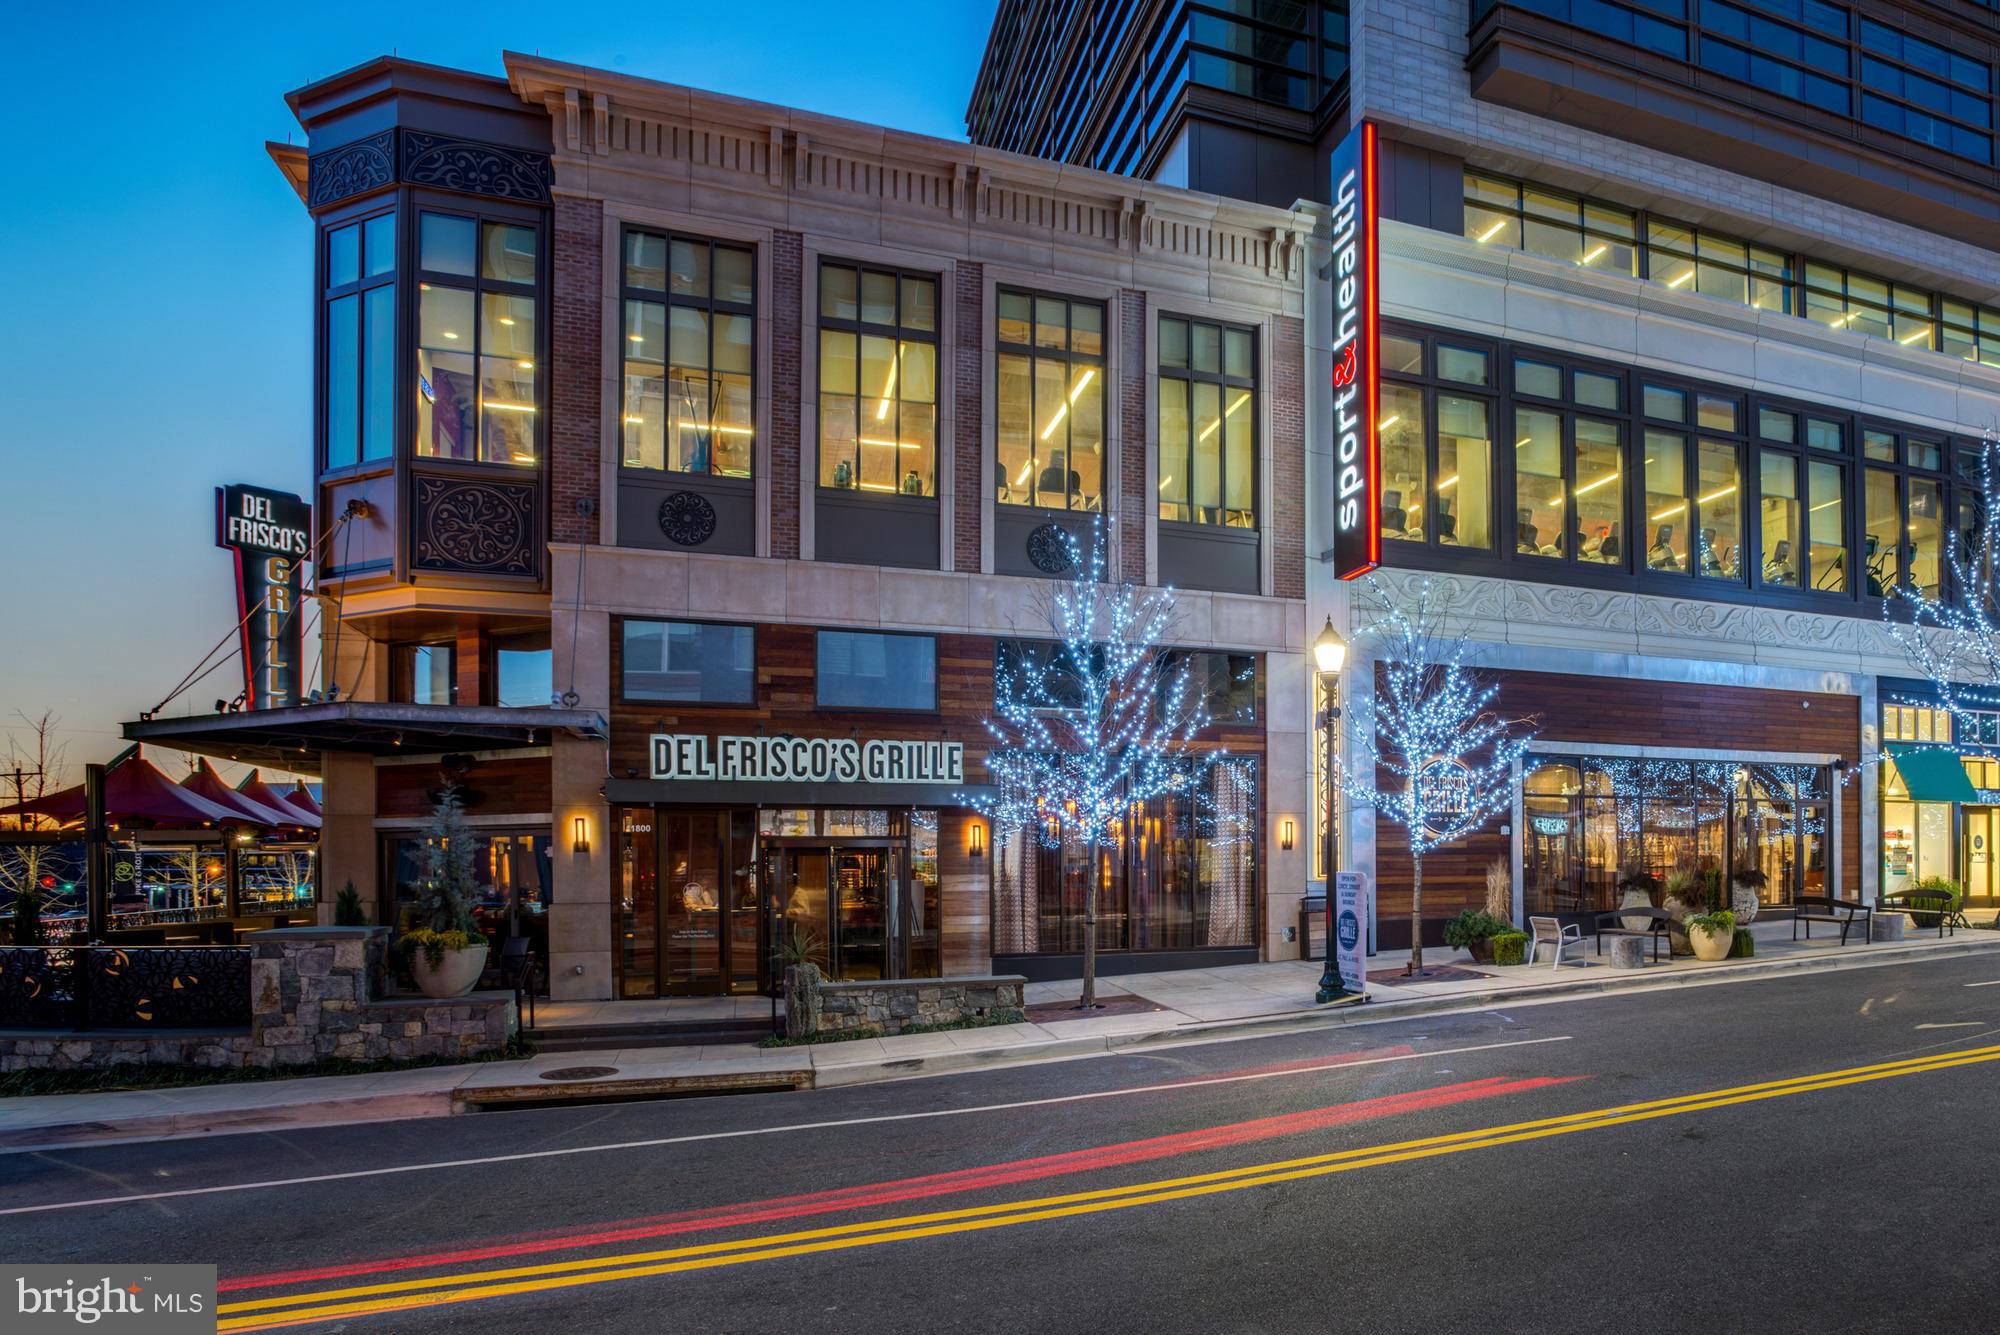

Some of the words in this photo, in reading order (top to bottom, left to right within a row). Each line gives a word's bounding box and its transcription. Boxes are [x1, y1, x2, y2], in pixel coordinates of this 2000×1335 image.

[1333, 168, 1363, 532] sport&health
[242, 493, 276, 523] DEL
[229, 516, 307, 554] FRISCO'S
[651, 735, 714, 779] DEL
[718, 737, 860, 781] FRISCO'S
[864, 741, 963, 783] GRILLE
[631, 824, 651, 833] 1800
